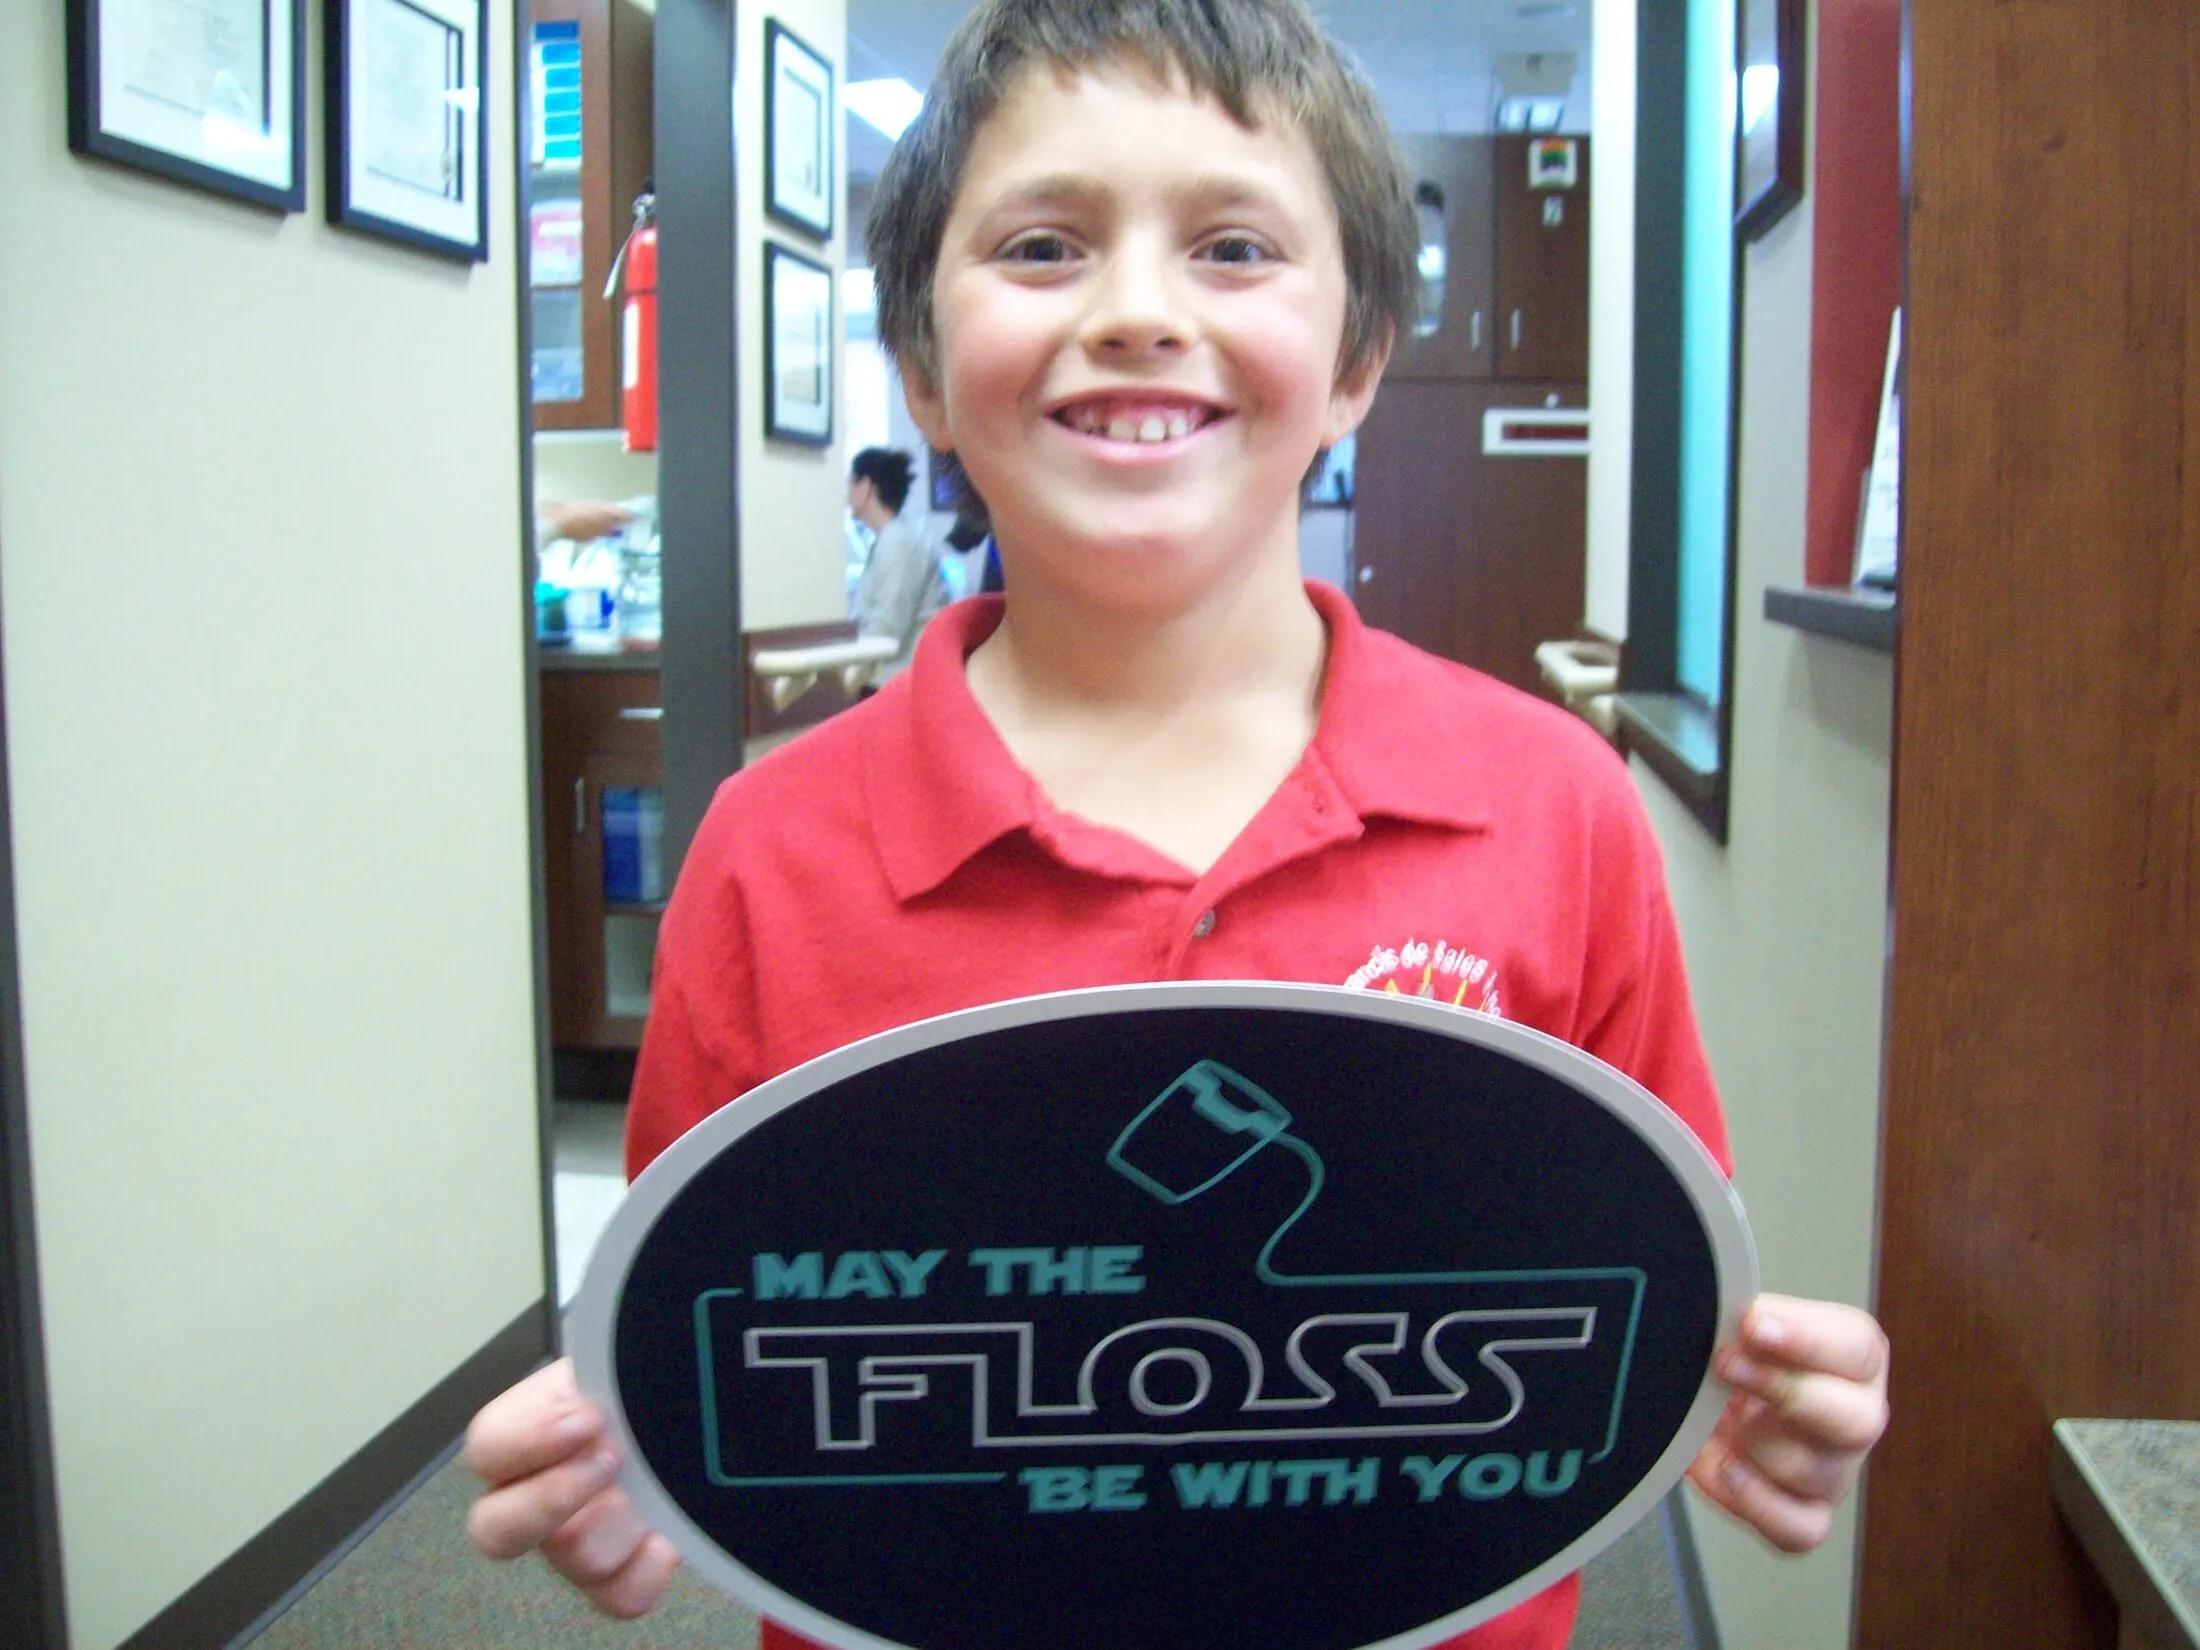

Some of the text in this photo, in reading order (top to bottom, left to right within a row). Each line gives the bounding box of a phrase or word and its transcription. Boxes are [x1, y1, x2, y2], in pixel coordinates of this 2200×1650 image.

[1400, 937, 1429, 969] de
[1432, 939, 1489, 984] Sales
[755, 1247, 1142, 1299] MAY THE
[745, 1307, 1596, 1449] FLOSS
[1021, 1451, 1579, 1510] BE WITH YOU
